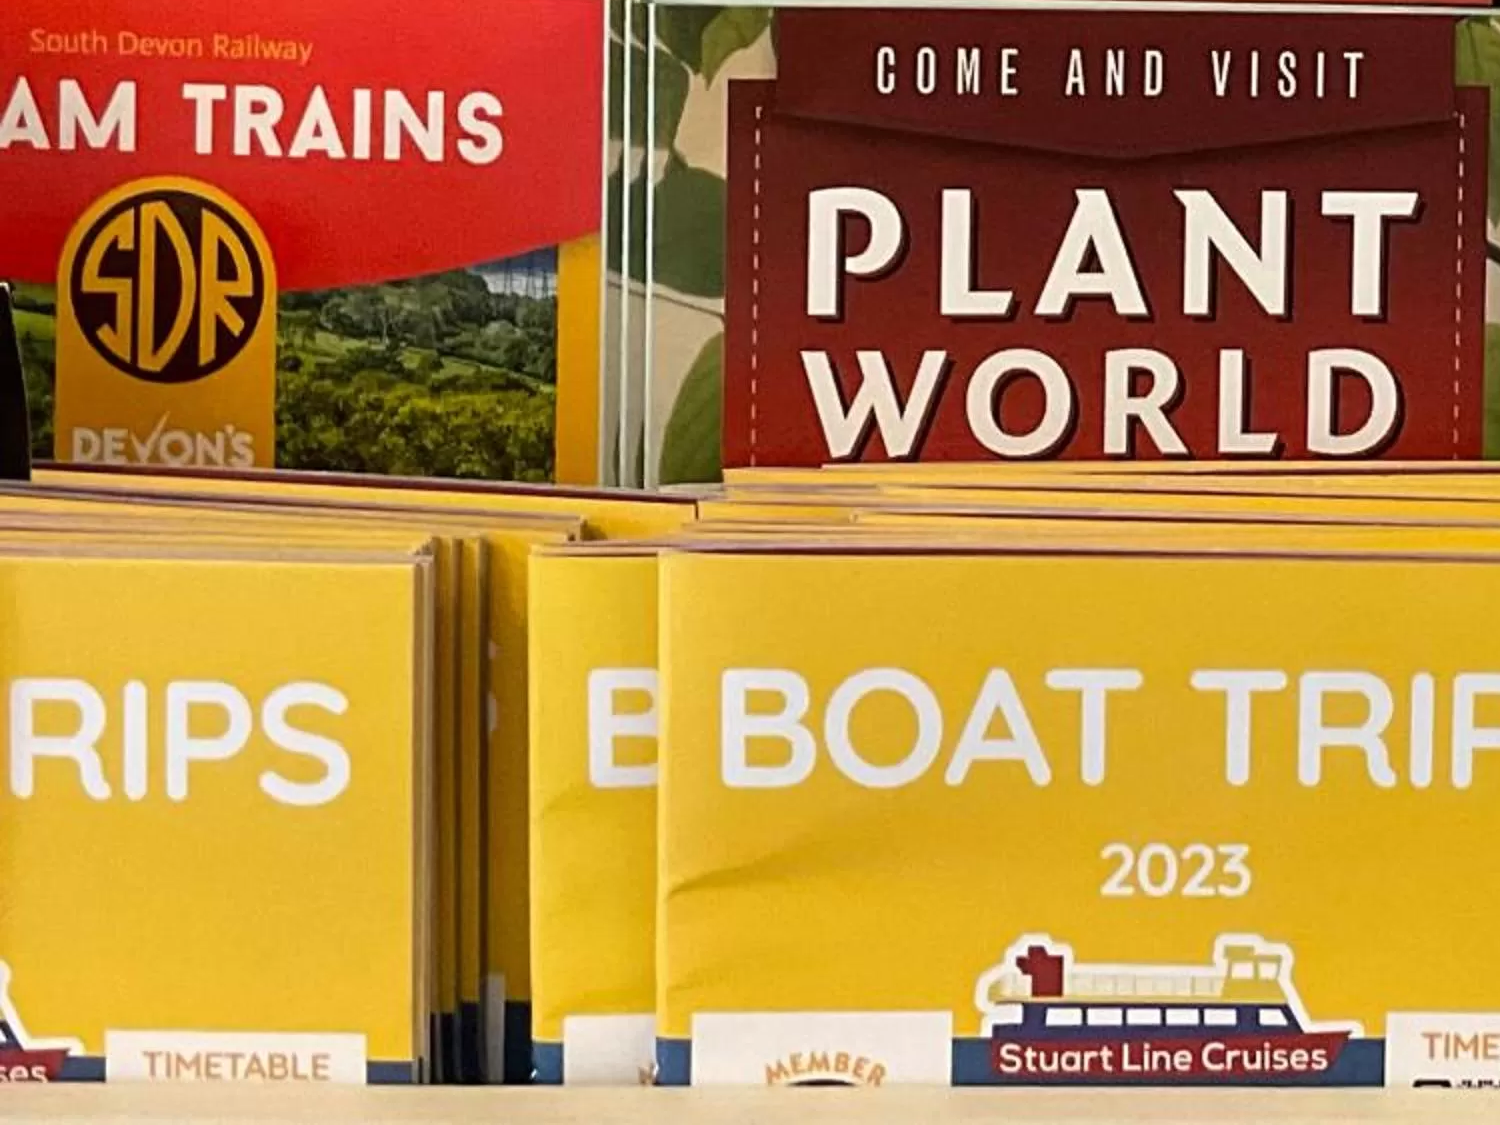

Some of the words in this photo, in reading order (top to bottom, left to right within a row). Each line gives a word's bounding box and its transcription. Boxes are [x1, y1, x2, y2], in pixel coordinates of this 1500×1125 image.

[30, 29, 107, 55] South
[118, 31, 203, 57] Devon
[213, 34, 313, 67] Railway
[877, 46, 1020, 96] COME
[1066, 49, 1164, 98] AND
[1212, 51, 1365, 100] VISIT
[0, 76, 137, 153] AM
[183, 83, 503, 165] TRAINS
[80, 200, 254, 373] SDR
[806, 185, 1422, 320] PLANT
[800, 348, 1402, 459] WORLD
[9, 677, 351, 806] RIPS
[721, 667, 1143, 788] BOAT
[1100, 842, 1252, 898] 2023
[142, 1050, 331, 1081] TIMETABLE
[766, 1049, 887, 1086] MEMBER
[999, 1041, 1118, 1074] Stuart
[1122, 1041, 1193, 1073] Line
[1202, 1040, 1329, 1073] Cruises
